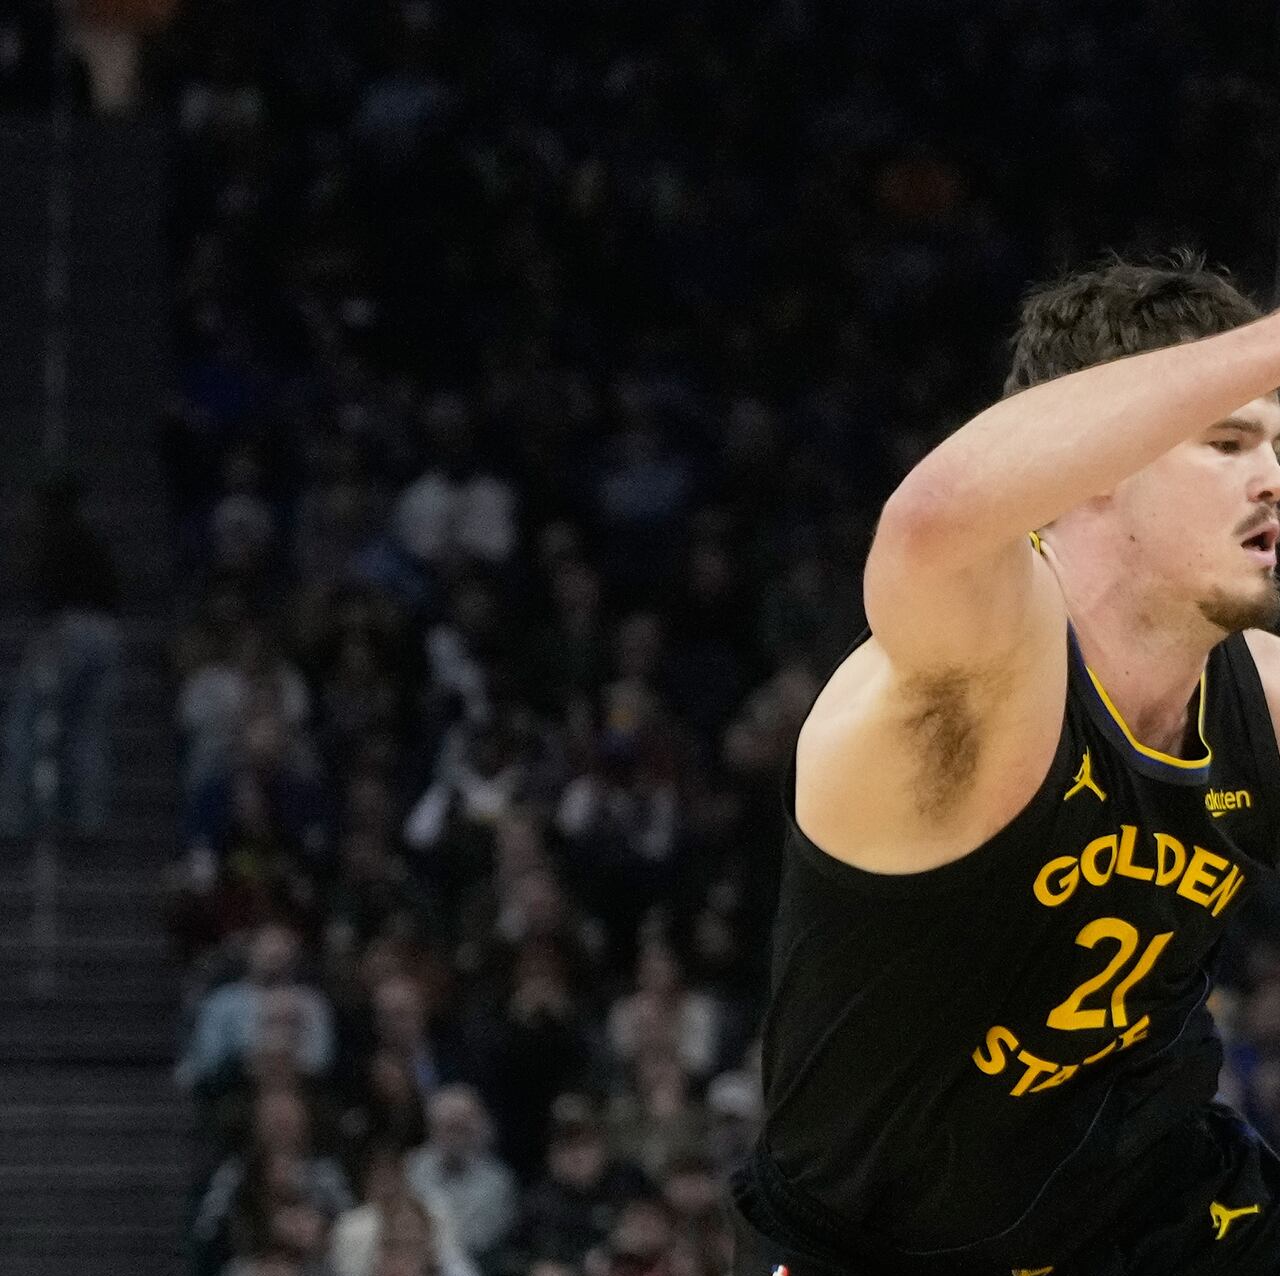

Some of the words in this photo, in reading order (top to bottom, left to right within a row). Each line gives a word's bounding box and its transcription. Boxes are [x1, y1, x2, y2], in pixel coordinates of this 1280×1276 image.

[1205, 788, 1251, 812] akuten
[1033, 825, 1245, 918] GOLDEN
[1046, 917, 1174, 1031] 21
